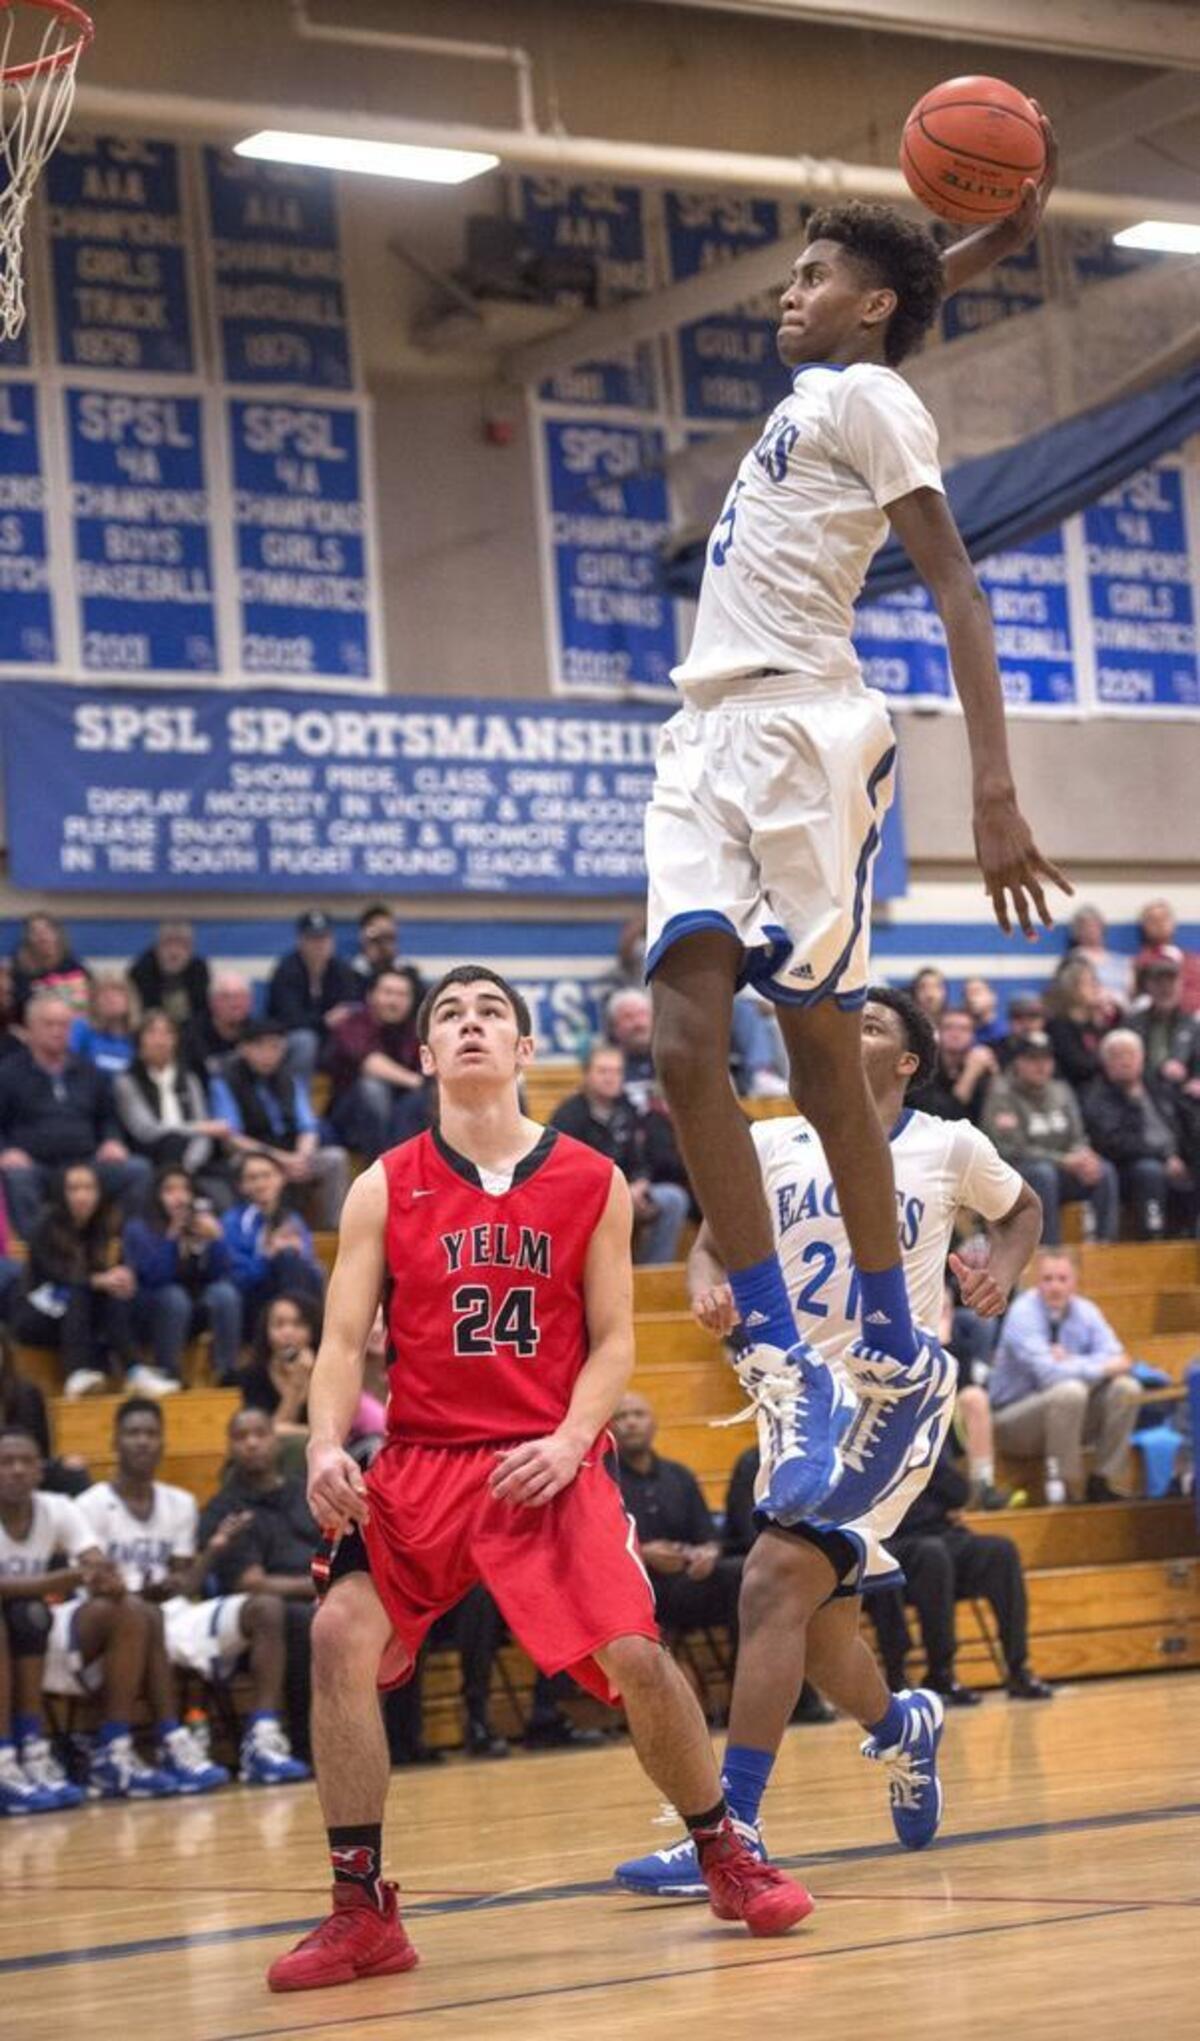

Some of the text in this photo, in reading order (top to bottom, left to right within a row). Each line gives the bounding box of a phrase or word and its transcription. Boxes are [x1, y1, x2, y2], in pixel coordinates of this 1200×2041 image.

[75, 247, 160, 287] GIRLS
[77, 394, 194, 450] SPSL
[242, 403, 347, 462] SPSL
[71, 481, 208, 525] CHAMPIONS
[232, 490, 367, 536] CHAMPIONS
[103, 523, 182, 563] BOYS
[260, 531, 346, 573] GIRLS
[1085, 546, 1189, 583] CHAMPIONS
[77, 560, 214, 604] BASEBALL
[238, 567, 367, 613] GYMNASTICS
[1106, 582, 1174, 619] GIRLS
[571, 586, 662, 630] TENNIS
[1094, 616, 1196, 656] GYMNASTICS
[74, 704, 211, 754] SPSL
[229, 762, 315, 793] SHOW
[86, 786, 193, 815] DISPLAY
[203, 788, 329, 818] MODESTY
[340, 791, 371, 819] IN
[379, 794, 485, 822] VICTORY
[496, 795, 519, 822] &
[63, 815, 156, 845] PLEASE
[169, 817, 255, 846] ENJOY
[268, 818, 315, 846] THE
[327, 819, 407, 848] GAME
[417, 822, 441, 850] &
[453, 822, 568, 852] PROMOTE
[60, 843, 95, 873] IN
[108, 844, 153, 873] THE
[168, 844, 259, 875] SOUTH
[269, 846, 353, 876] PUGET
[363, 847, 457, 876] SOUND
[440, 1222, 552, 1279] YELM
[452, 1283, 542, 1358] 24
